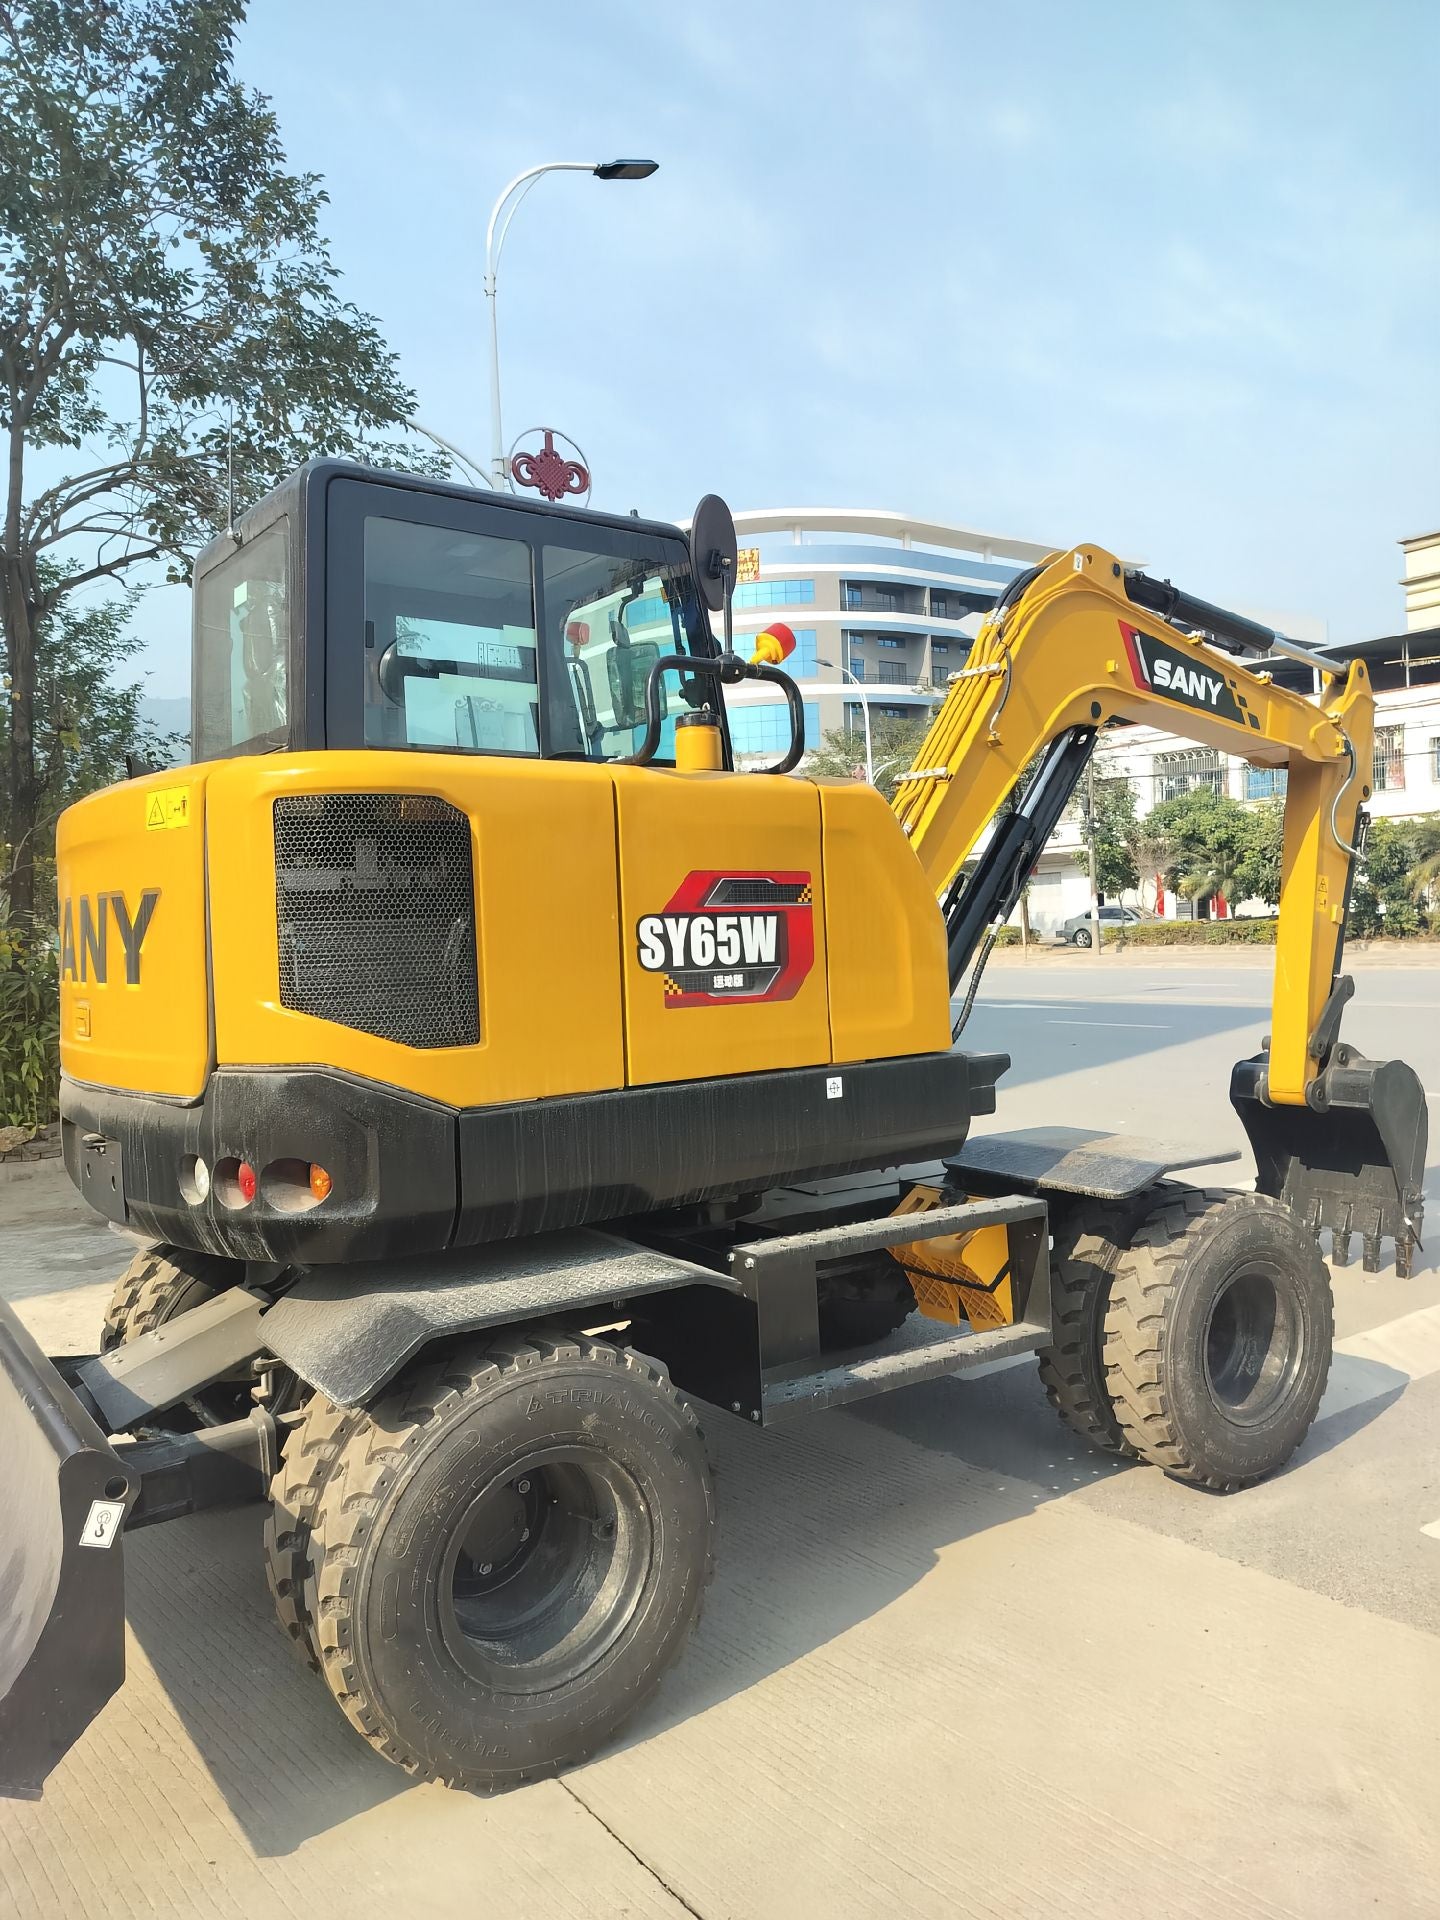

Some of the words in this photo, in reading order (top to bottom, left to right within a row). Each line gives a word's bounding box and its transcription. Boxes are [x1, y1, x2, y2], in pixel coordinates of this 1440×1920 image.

[1153, 659, 1224, 706] SANY
[61, 888, 162, 985] ANY
[638, 916, 778, 969] SY65W
